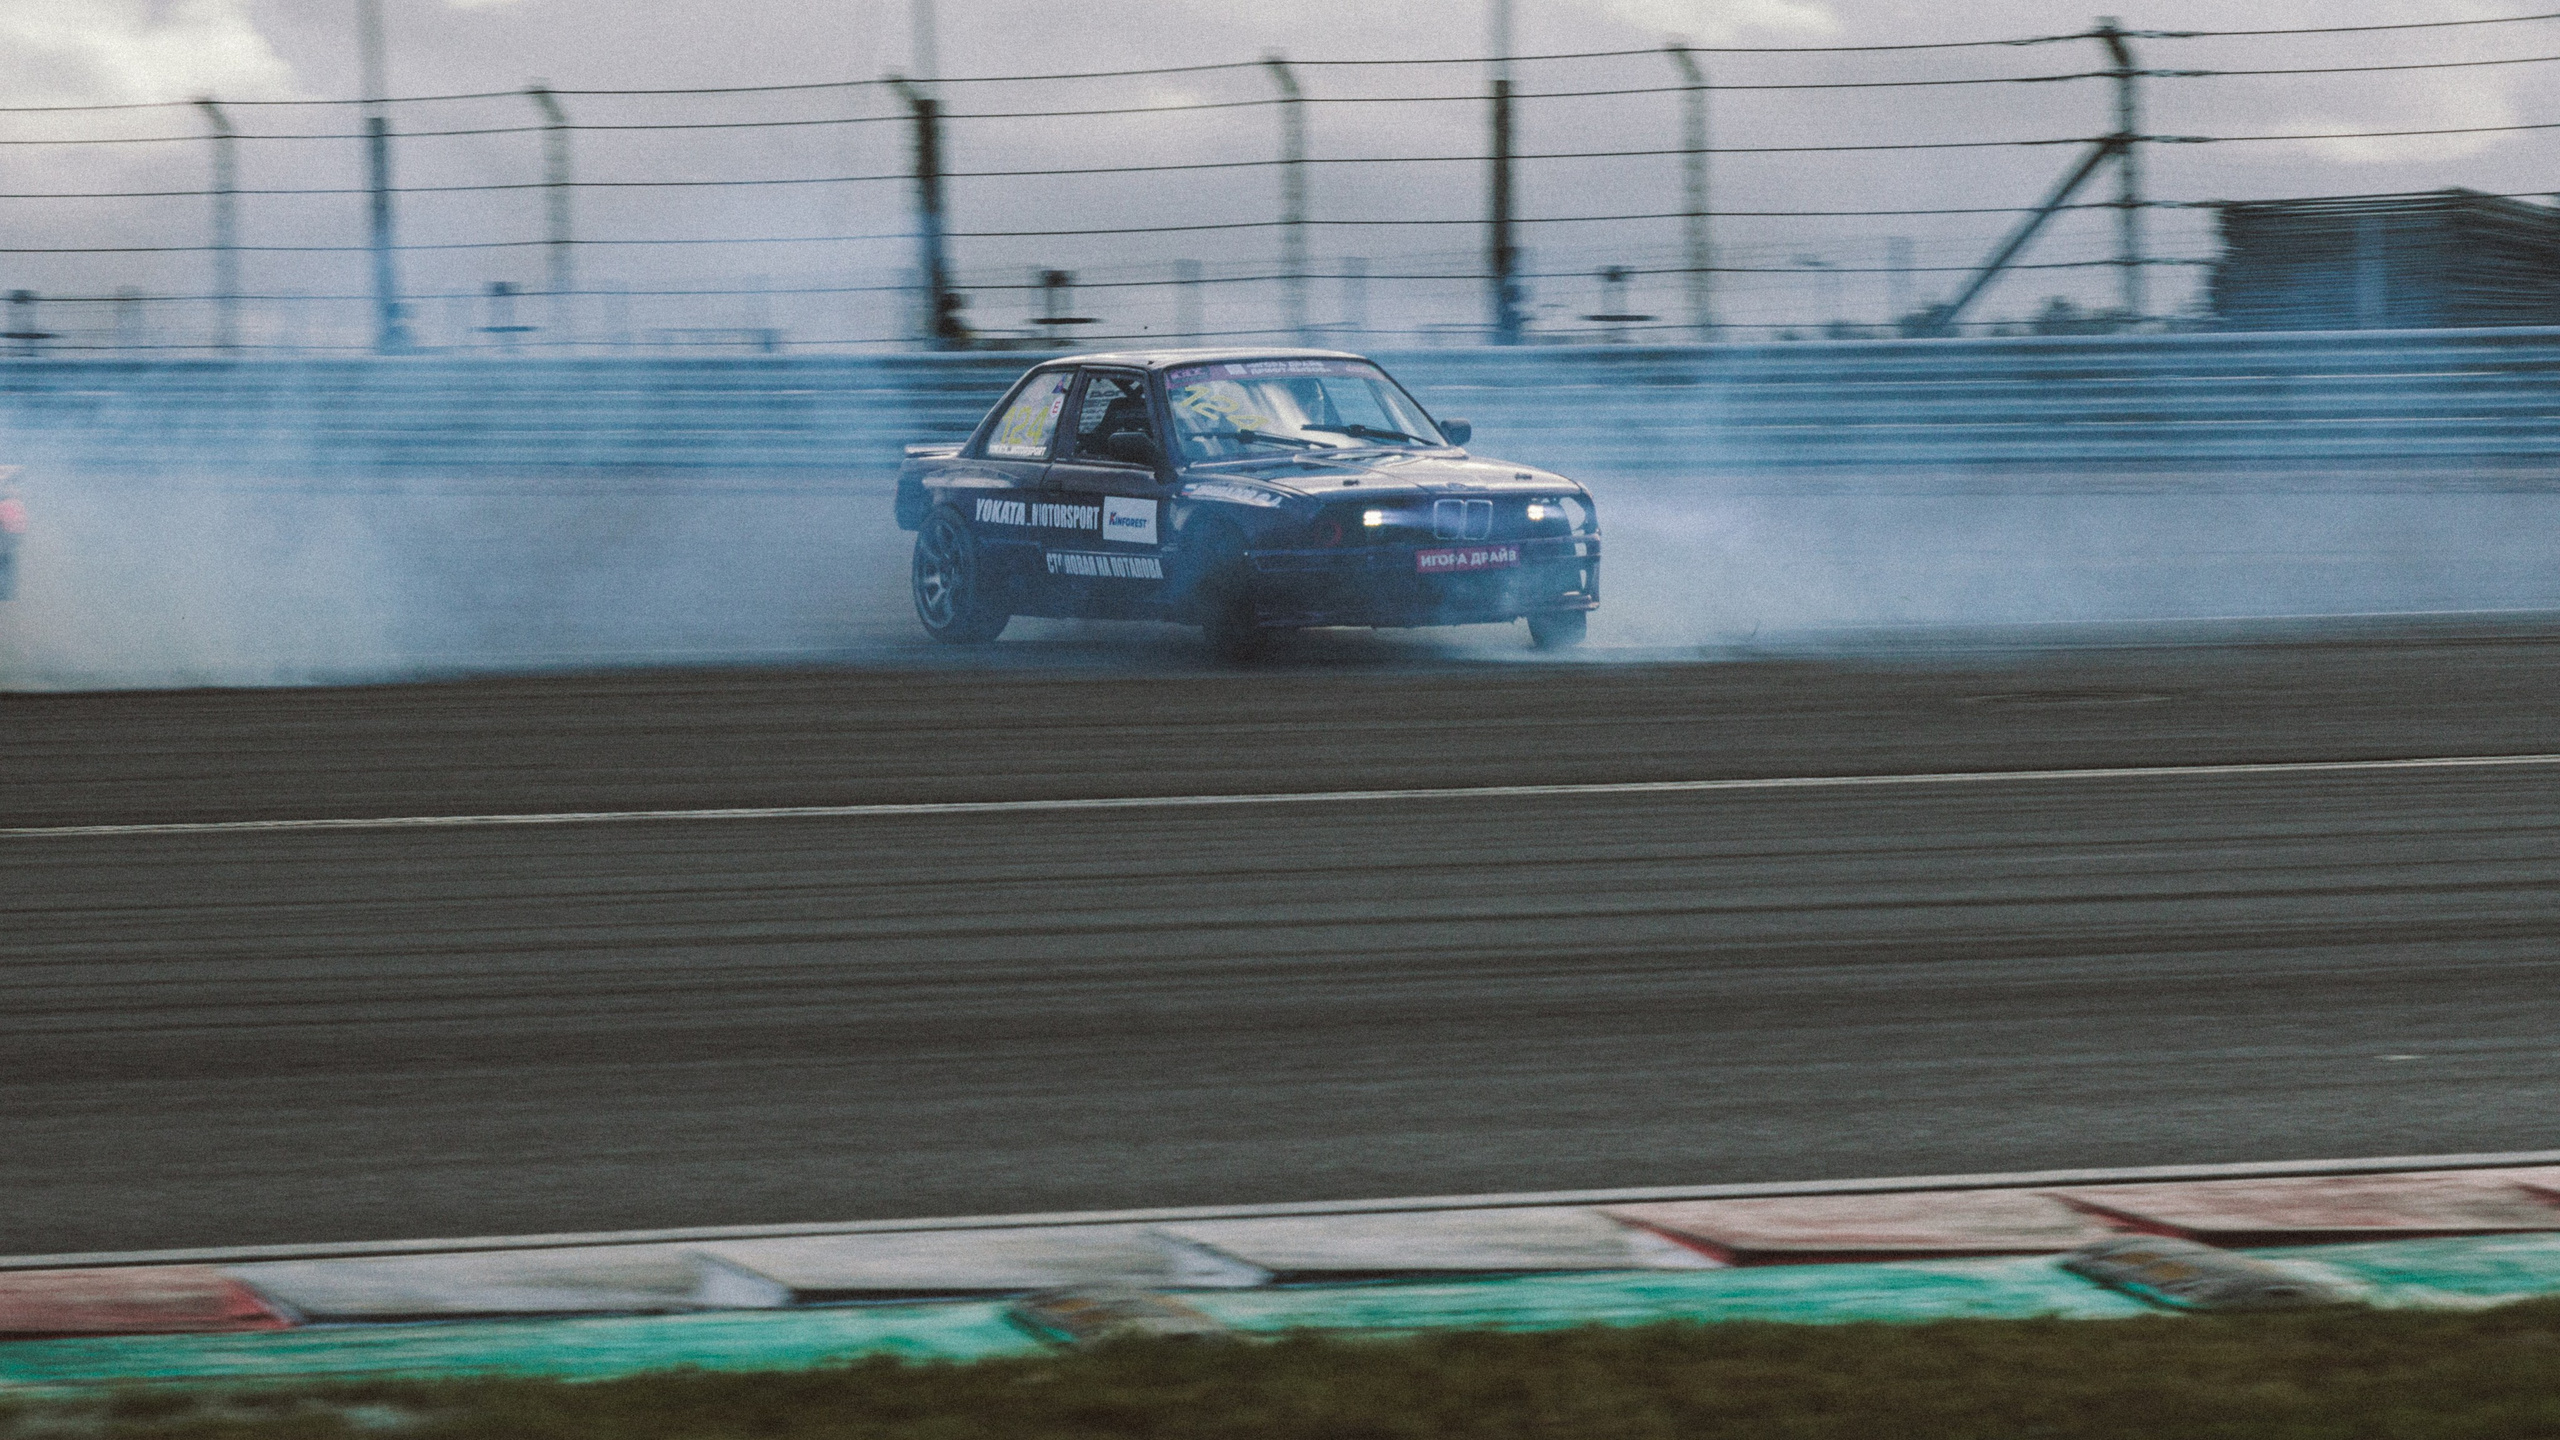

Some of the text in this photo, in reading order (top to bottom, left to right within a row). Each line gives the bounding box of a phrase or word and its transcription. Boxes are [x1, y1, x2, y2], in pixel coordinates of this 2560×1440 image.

[1001, 405, 1050, 446] 124
[1421, 548, 1517, 567] ИГОРА ДРАЙВ
